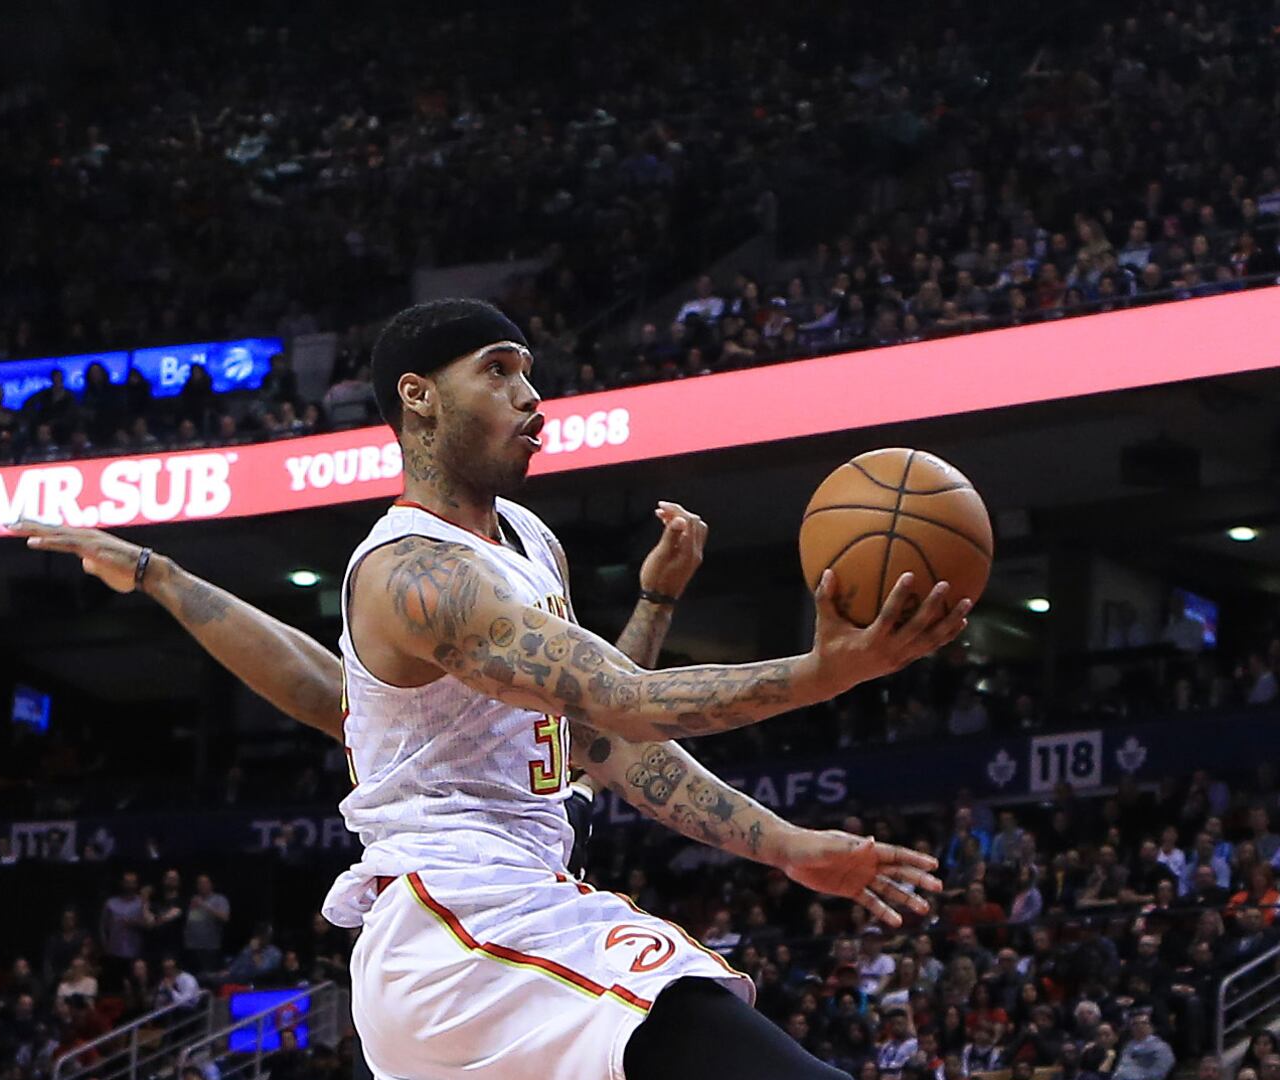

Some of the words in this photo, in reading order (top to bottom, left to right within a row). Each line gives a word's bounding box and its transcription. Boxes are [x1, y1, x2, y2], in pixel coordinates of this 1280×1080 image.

[285, 442, 404, 491] YOURS
[543, 408, 630, 454] 1968
[1037, 741, 1094, 781] 118
